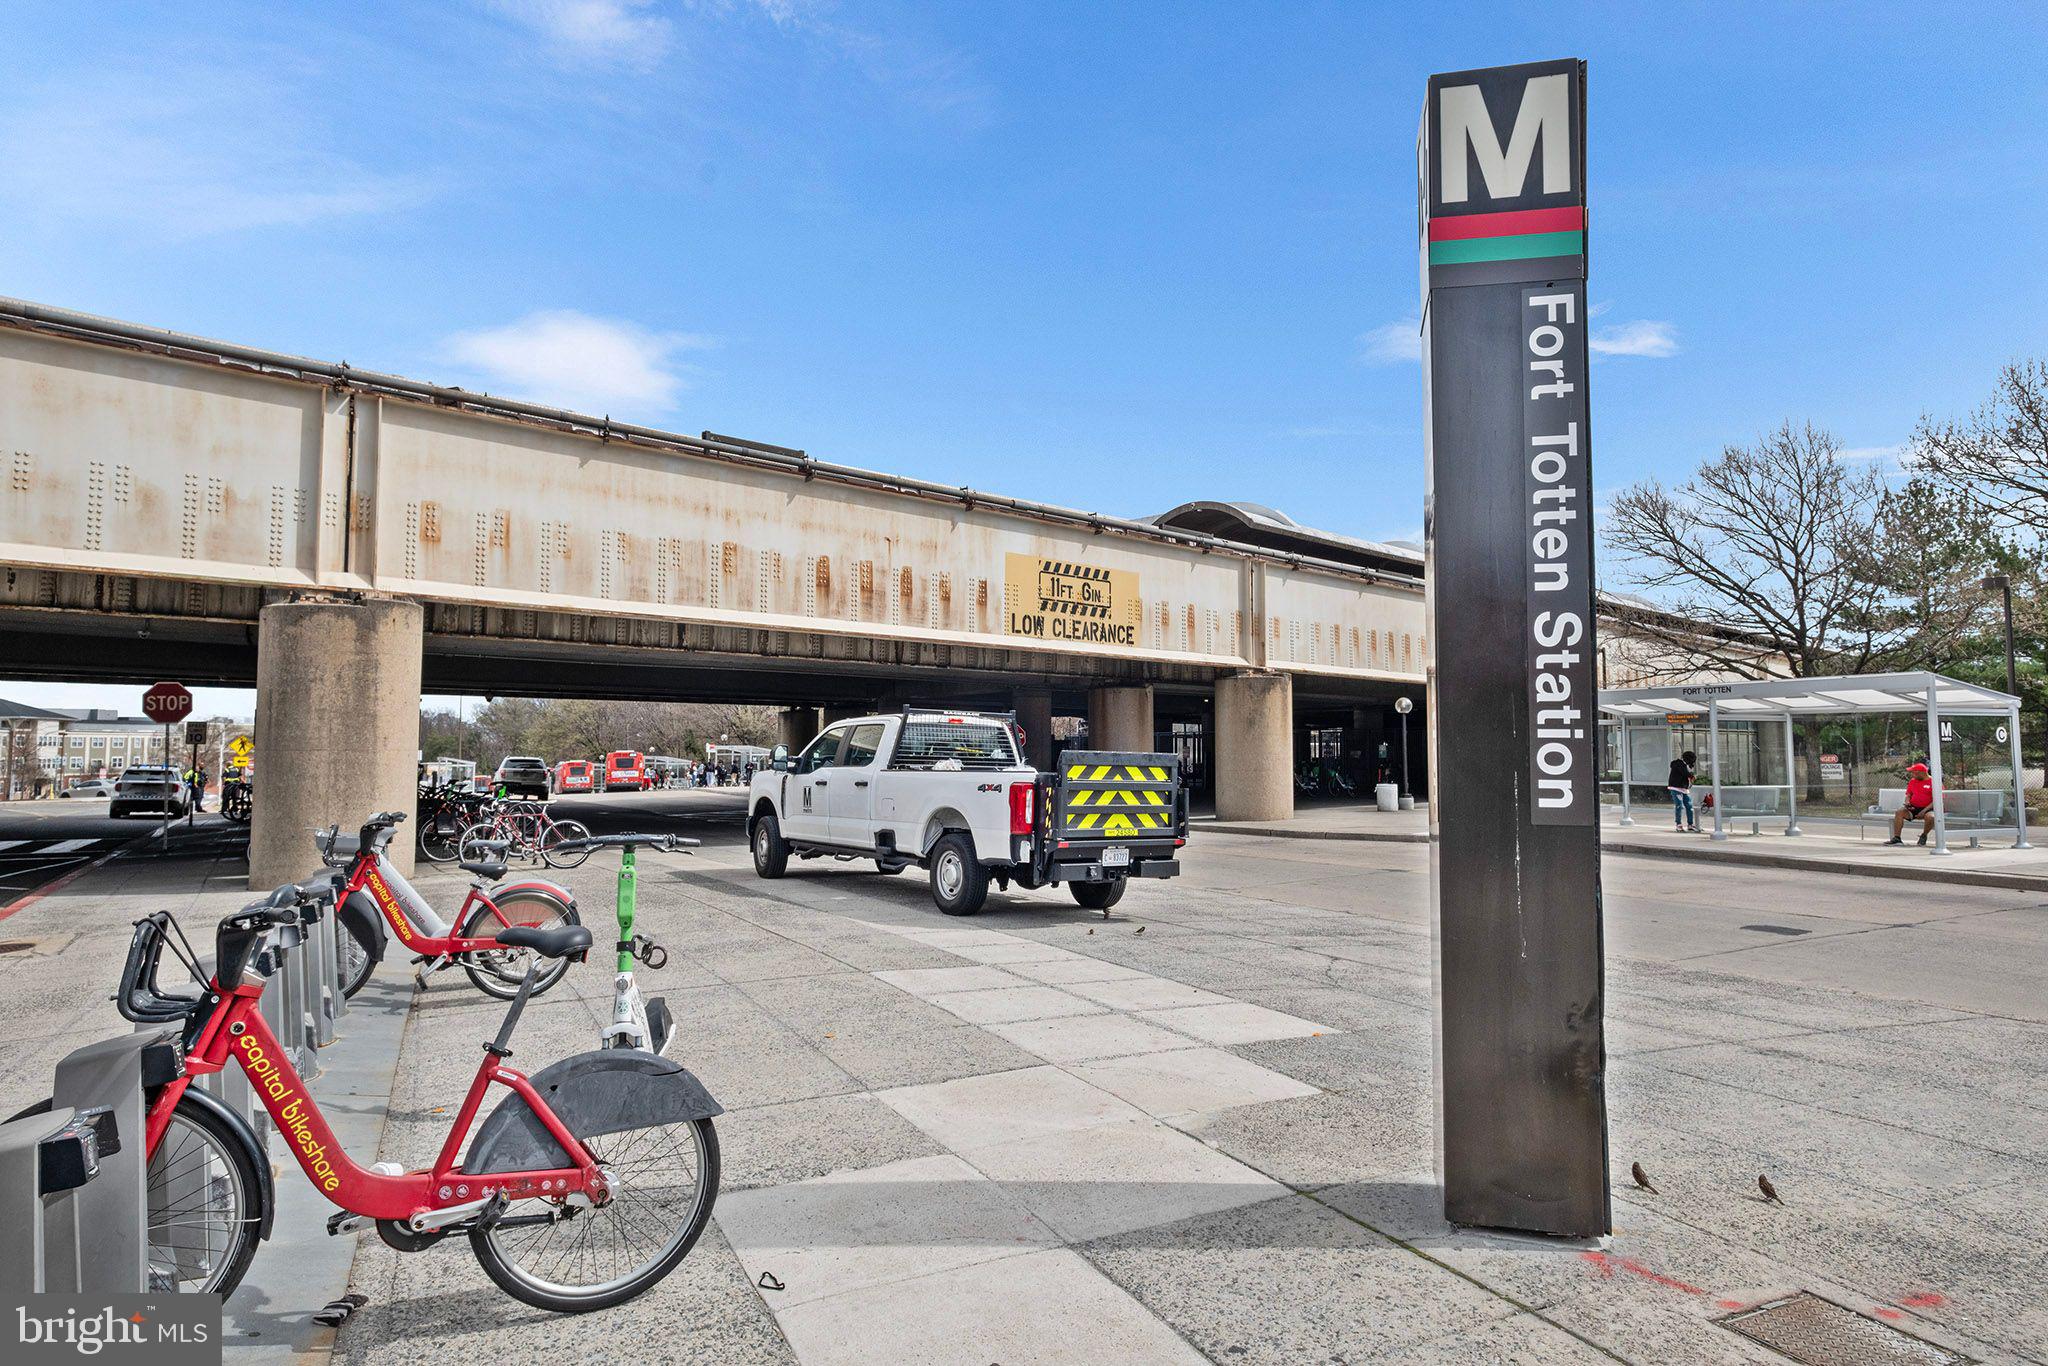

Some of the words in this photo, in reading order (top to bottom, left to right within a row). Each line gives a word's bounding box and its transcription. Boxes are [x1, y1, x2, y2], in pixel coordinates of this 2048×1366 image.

[1440, 73, 1570, 203] M
[1529, 294, 1576, 400] Fort
[1531, 422, 1577, 592] Totten
[1011, 613, 1045, 636] LOW
[1052, 617, 1135, 645] CLEARANCE
[146, 695, 189, 711] STOP
[1534, 611, 1584, 808] Station
[1682, 687, 1701, 695] FORT
[1704, 686, 1732, 694] TOTTEN
[1940, 722, 1952, 737] M
[803, 786, 812, 808] M
[370, 873, 392, 902] capital
[387, 901, 412, 940] bikeshare
[240, 1035, 293, 1102] capital
[281, 1098, 340, 1191] bikeshare
